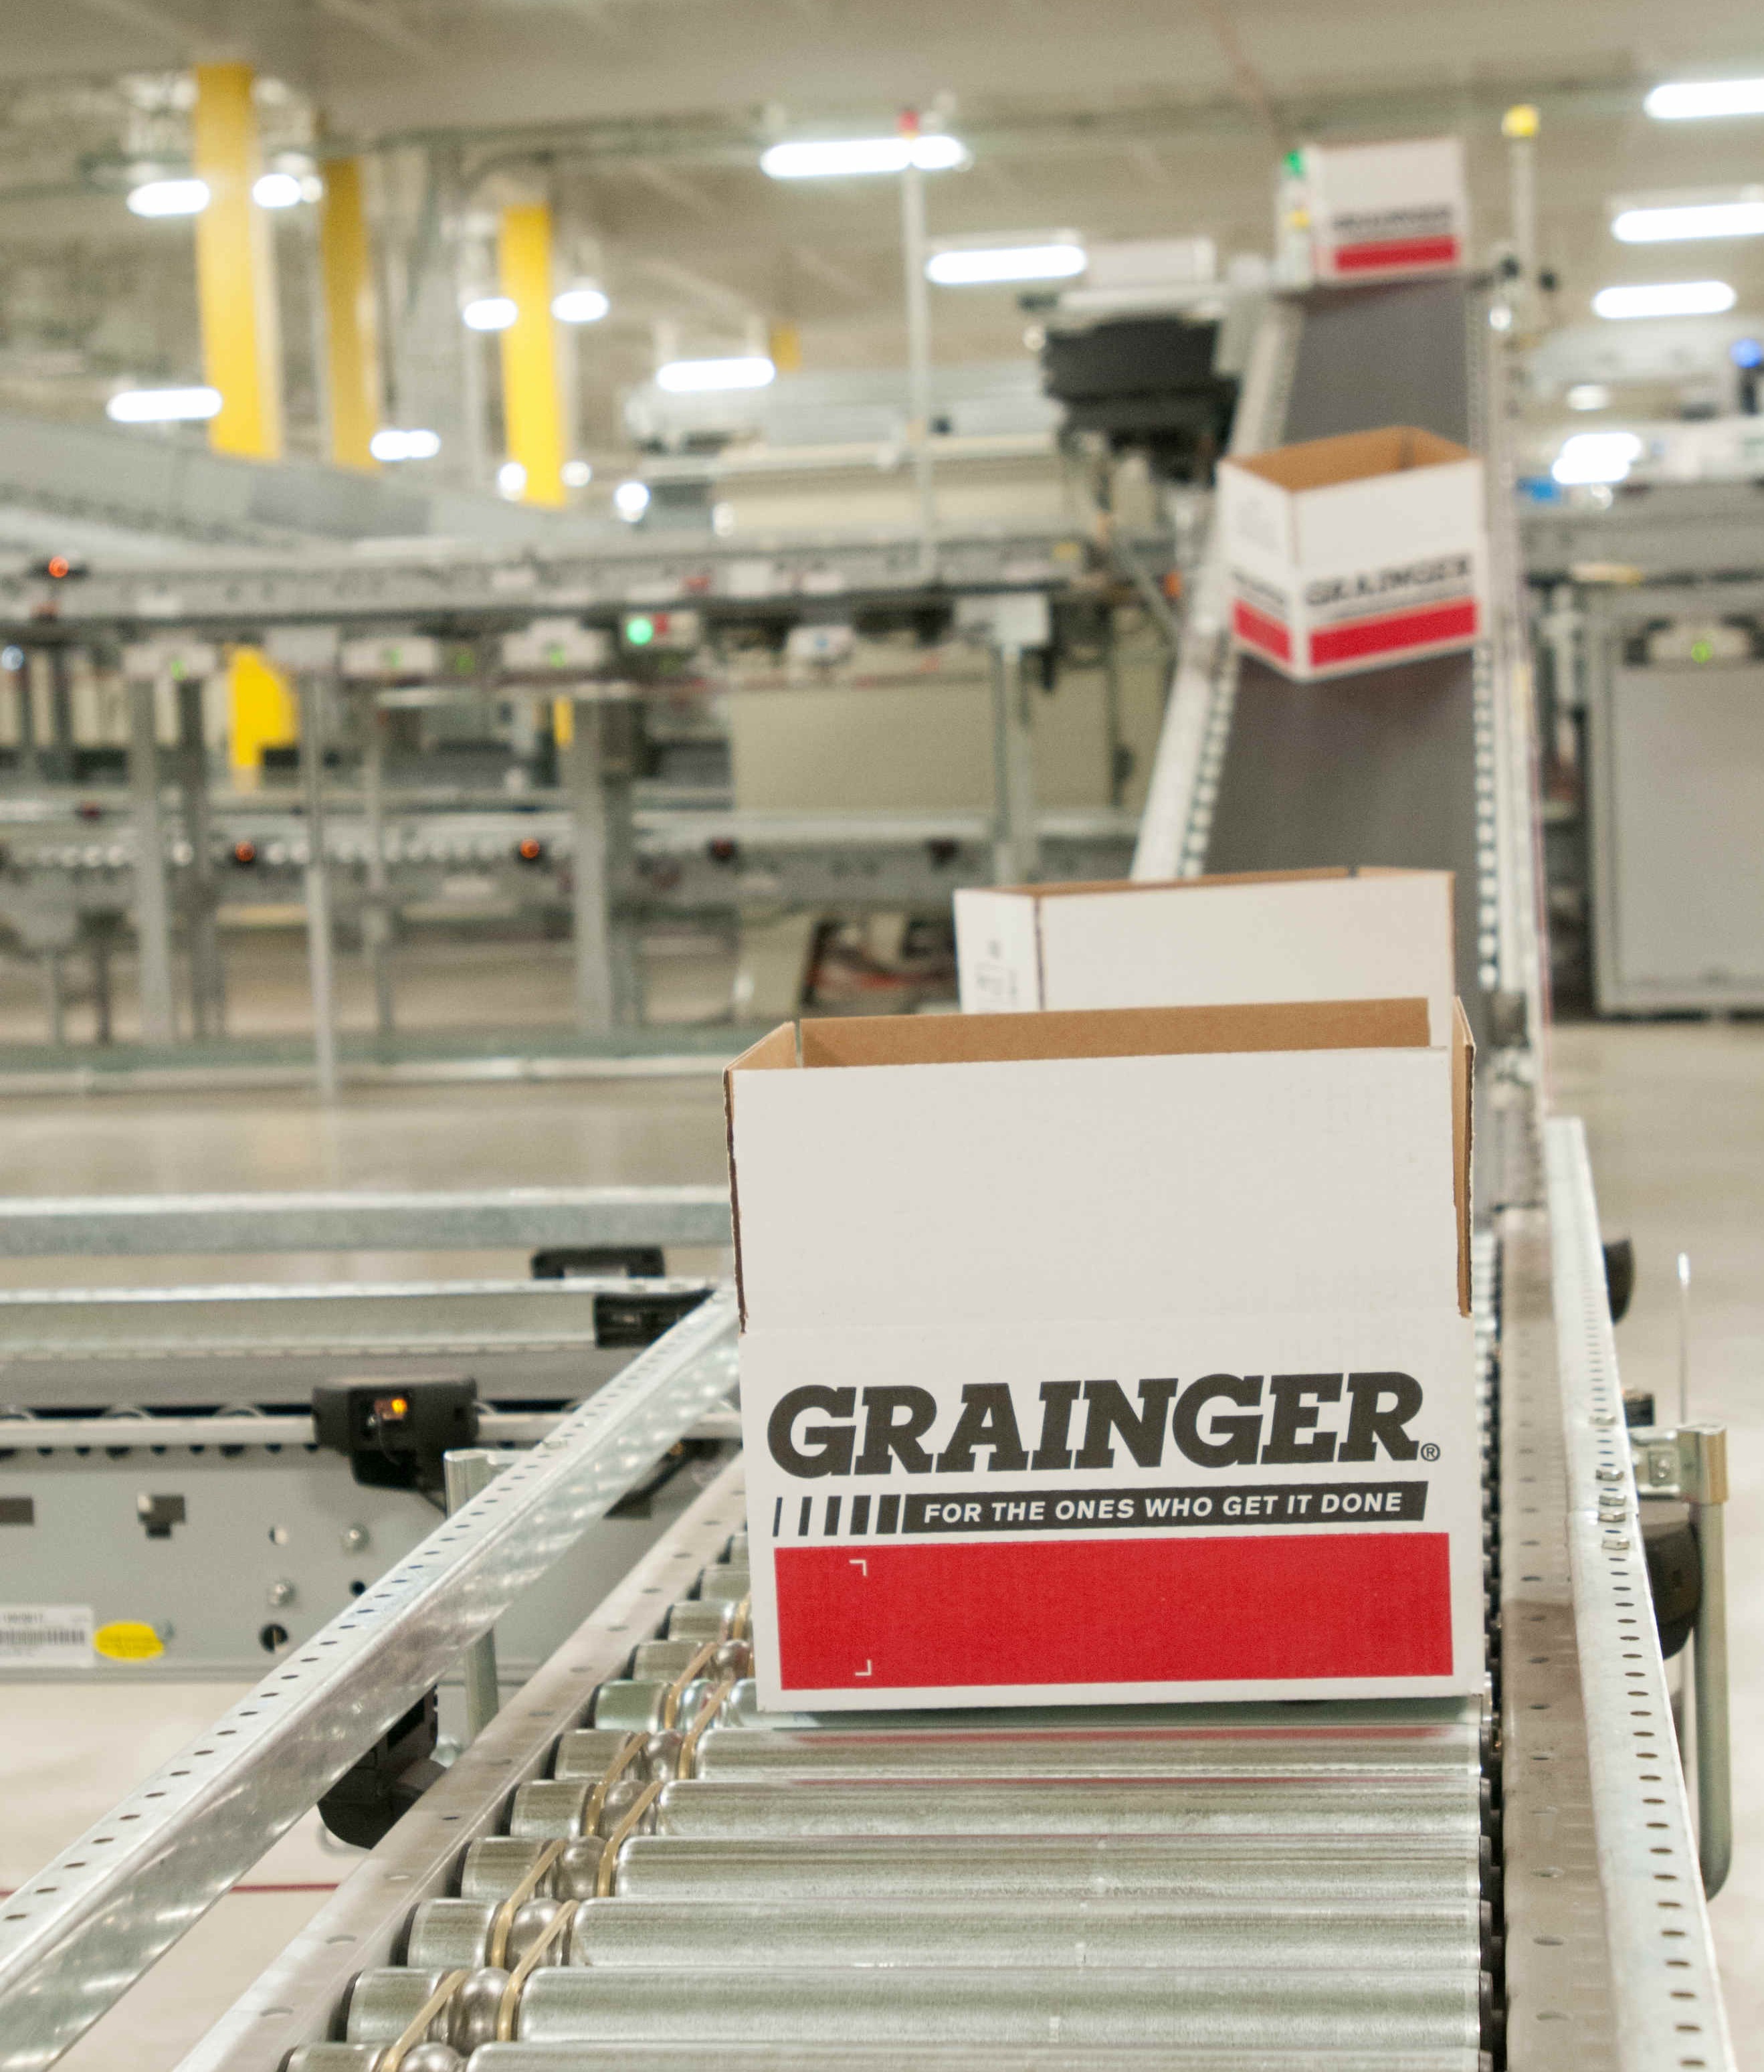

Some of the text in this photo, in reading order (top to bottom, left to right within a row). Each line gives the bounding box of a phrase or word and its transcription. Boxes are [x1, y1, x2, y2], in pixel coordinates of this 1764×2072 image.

[924, 1493, 1402, 1523] FOR THE ONES WHO GET IT DONE
